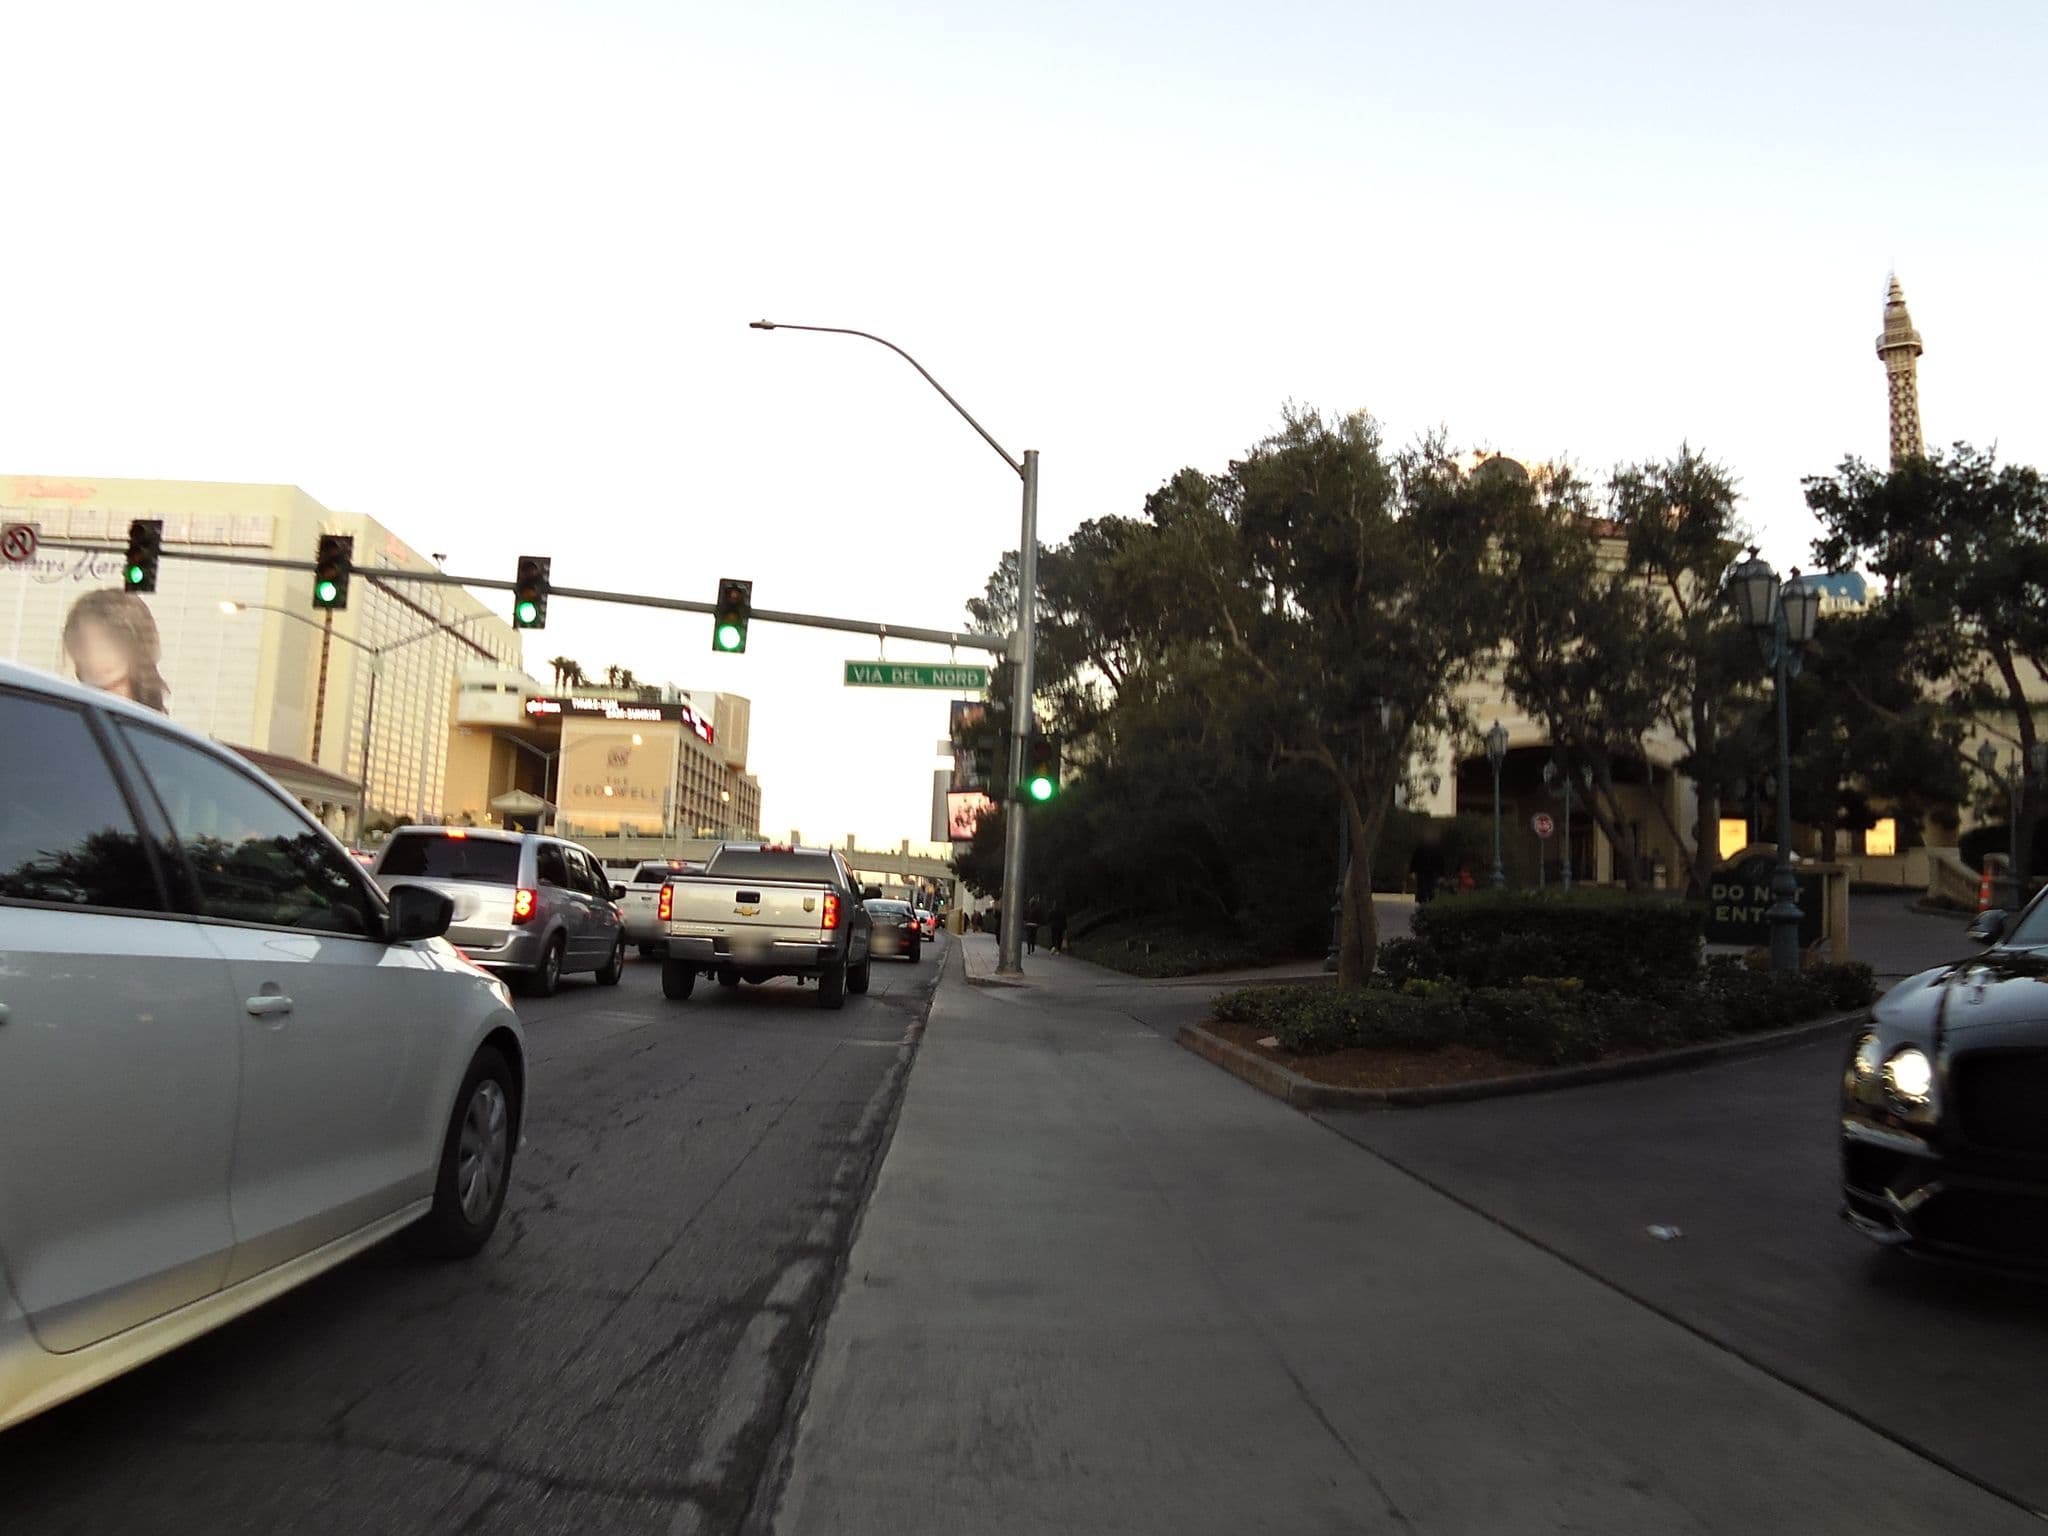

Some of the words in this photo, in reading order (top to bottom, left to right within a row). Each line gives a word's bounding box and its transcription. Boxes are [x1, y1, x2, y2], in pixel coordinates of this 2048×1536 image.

[853, 666, 883, 683] VIA
[892, 668, 924, 685] DEL
[932, 669, 979, 687] NORD
[1712, 884, 1744, 900] DO
[1754, 885, 1804, 902] NT
